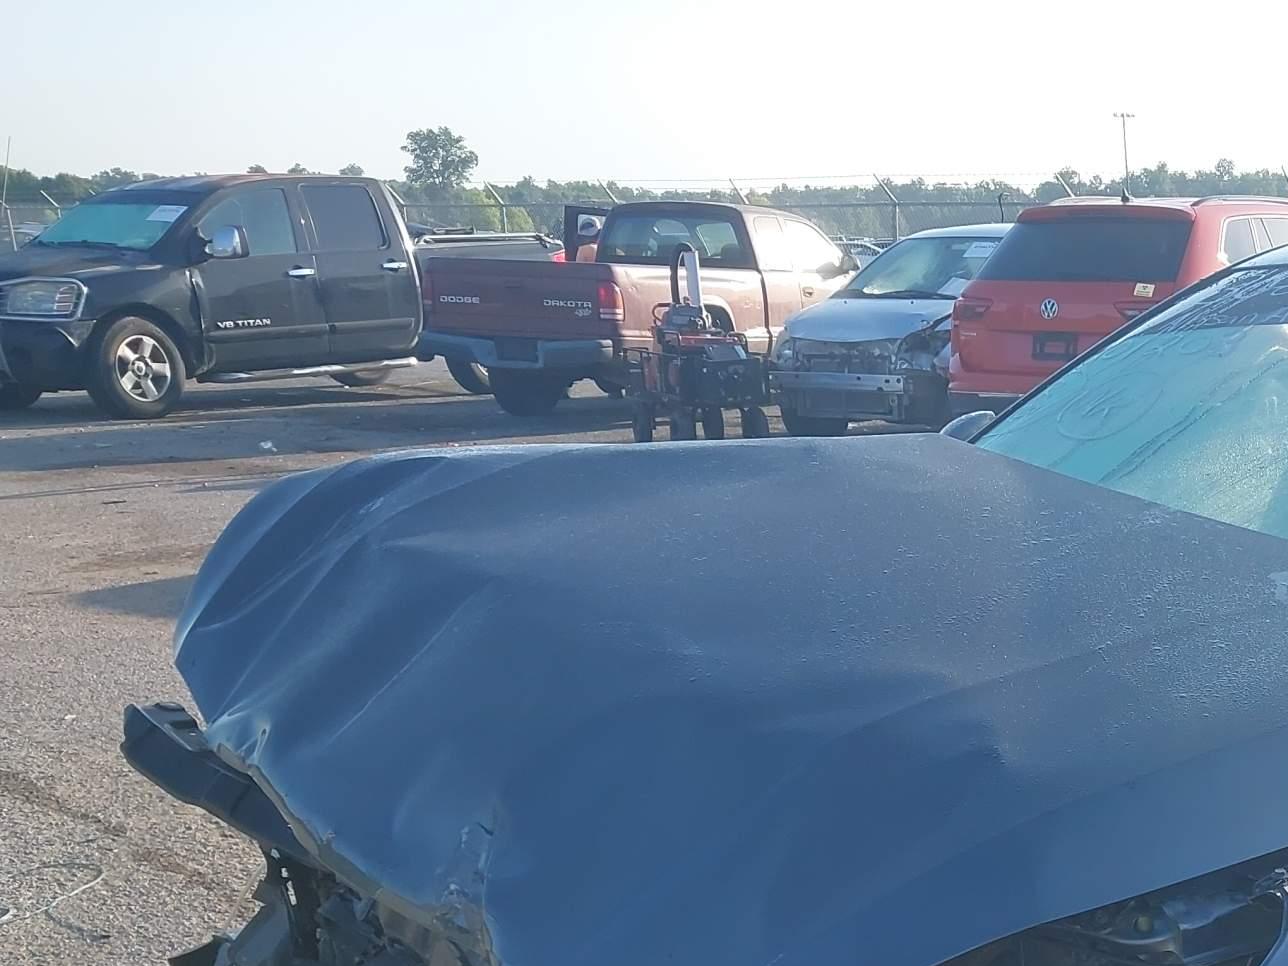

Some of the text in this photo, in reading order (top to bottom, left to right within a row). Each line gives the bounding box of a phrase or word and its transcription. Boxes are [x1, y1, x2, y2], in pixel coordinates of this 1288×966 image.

[439, 295, 480, 304] DODGE
[543, 299, 592, 308] DAKOTA
[217, 318, 272, 329] V8 TITAN
